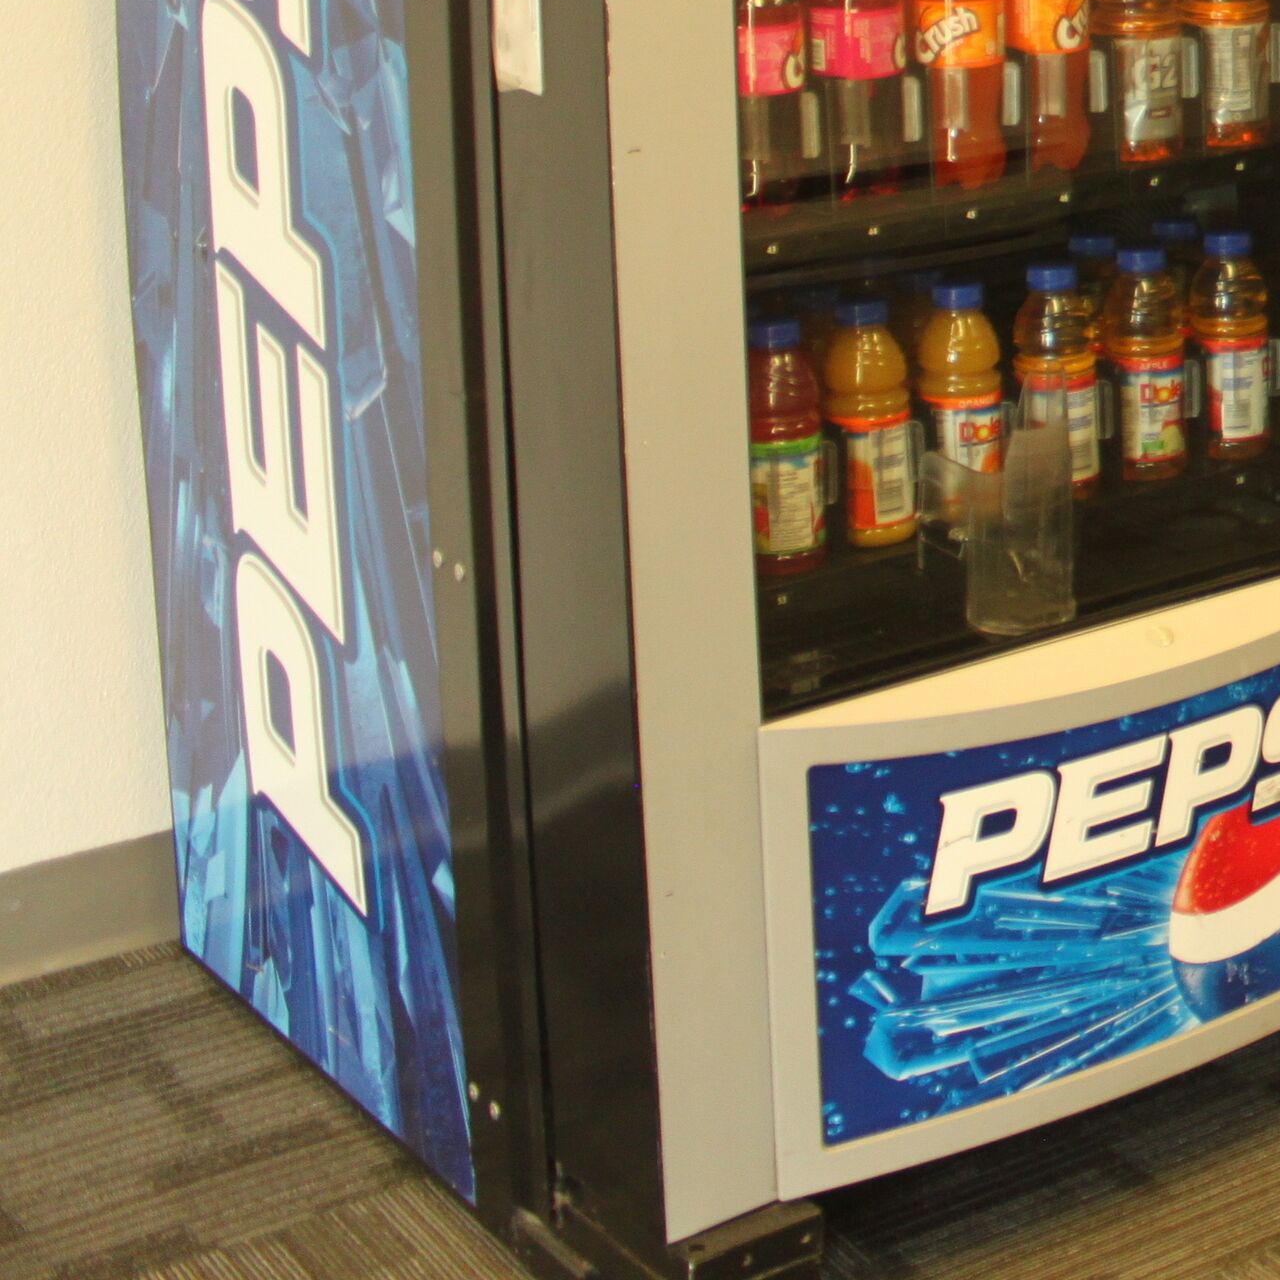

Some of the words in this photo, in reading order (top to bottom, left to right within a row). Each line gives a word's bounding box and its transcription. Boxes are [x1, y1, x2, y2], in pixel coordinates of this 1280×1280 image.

[915, 6, 979, 65] Crush
[958, 394, 996, 410] ORANG
[1139, 379, 1181, 404] Dole
[959, 420, 1002, 443] Dole
